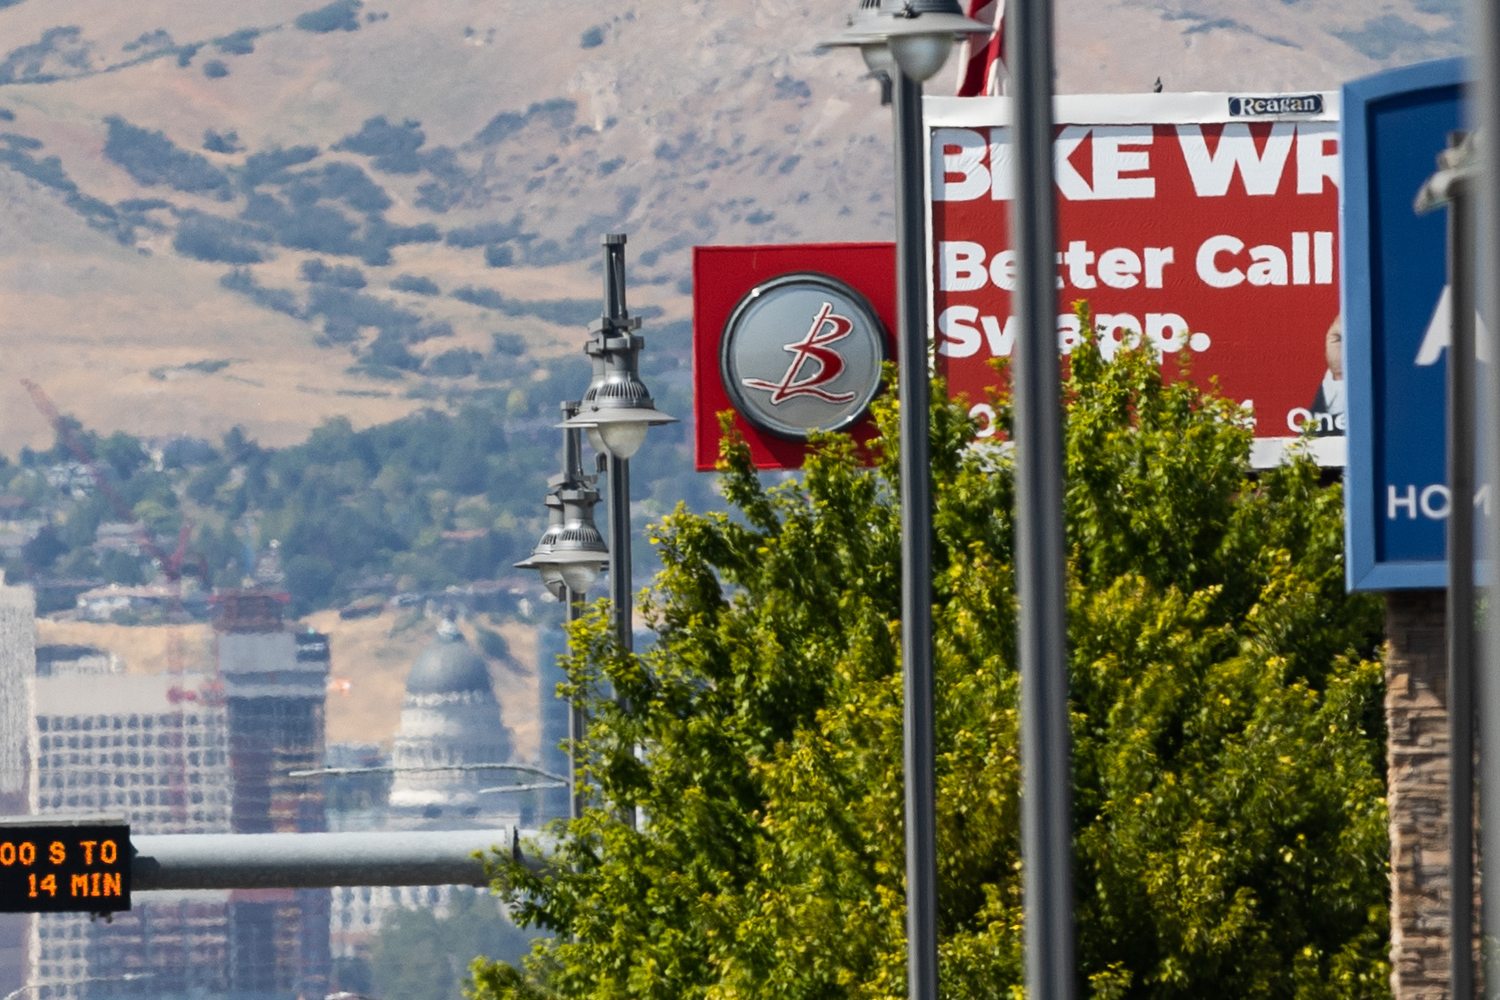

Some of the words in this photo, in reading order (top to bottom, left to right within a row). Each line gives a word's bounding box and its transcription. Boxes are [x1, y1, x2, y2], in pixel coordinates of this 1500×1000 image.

[1239, 96, 1316, 115] Reagan
[1195, 231, 1334, 288] Call
[49, 841, 67, 865] S
[80, 839, 118, 865] TO
[28, 872, 57, 898] 14
[71, 872, 122, 897] MIN
